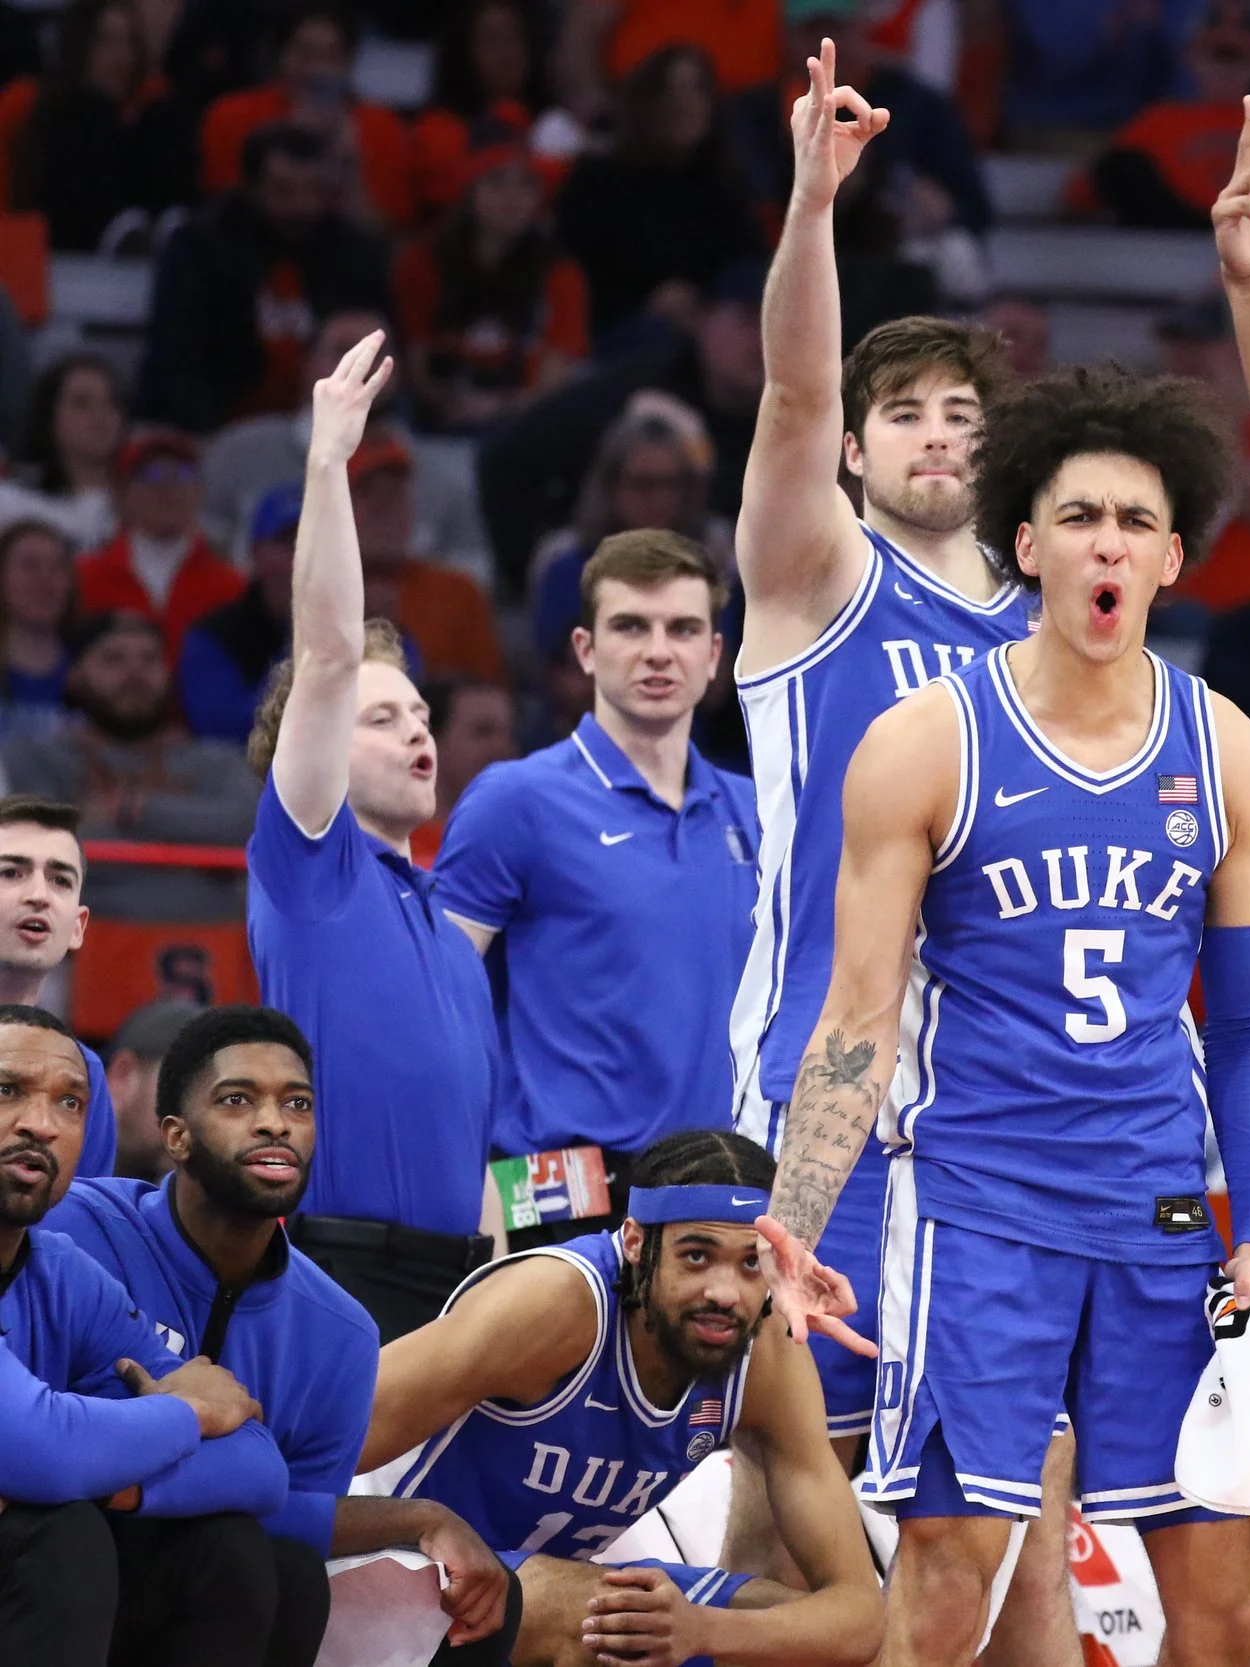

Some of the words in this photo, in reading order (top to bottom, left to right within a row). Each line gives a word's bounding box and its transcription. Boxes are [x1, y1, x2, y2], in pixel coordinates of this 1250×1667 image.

[881, 639, 976, 699] DU
[982, 846, 1203, 921] DUKE
[1064, 929, 1127, 1044] 5
[522, 1441, 690, 1516] DUK
